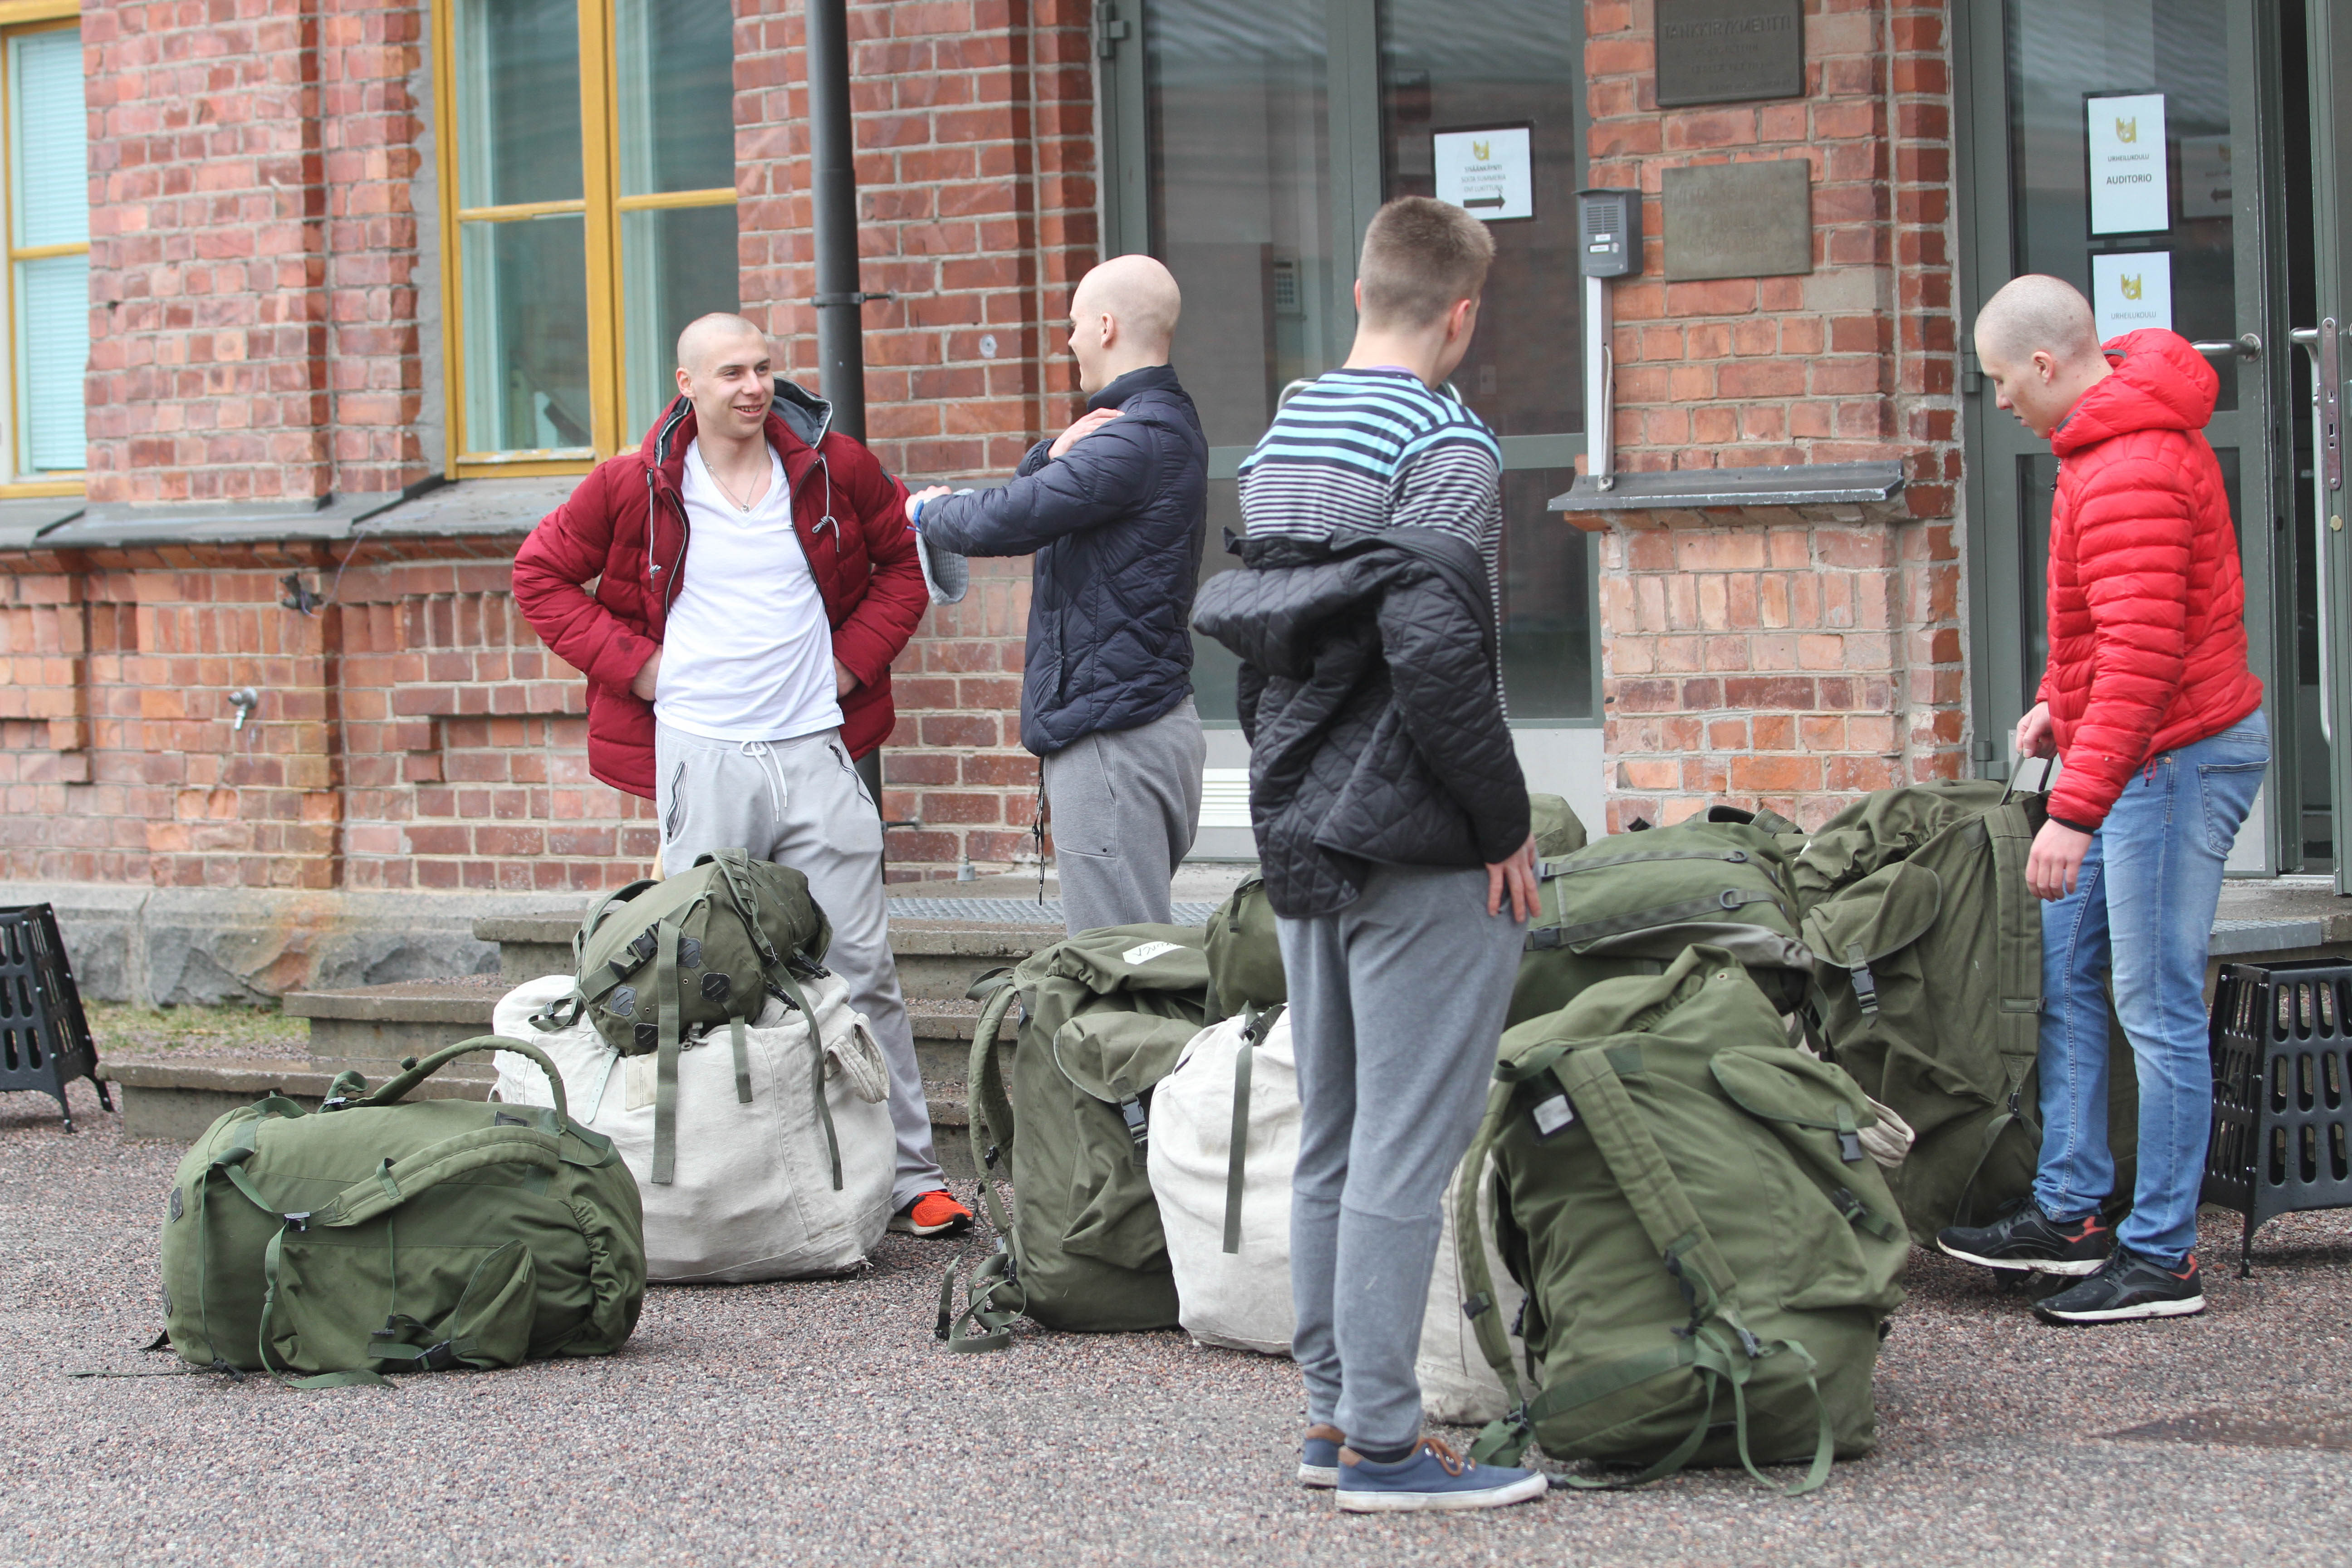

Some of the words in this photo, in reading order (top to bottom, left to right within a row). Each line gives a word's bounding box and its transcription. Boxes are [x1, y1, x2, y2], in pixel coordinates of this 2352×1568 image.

[1663, 16, 1791, 39] TANKKIRYKMENTTI
[2107, 153, 2150, 162] URHEILUKOULU
[2106, 173, 2152, 185] AUDITORIO
[2111, 311, 2156, 320] URHEILUKOULU
